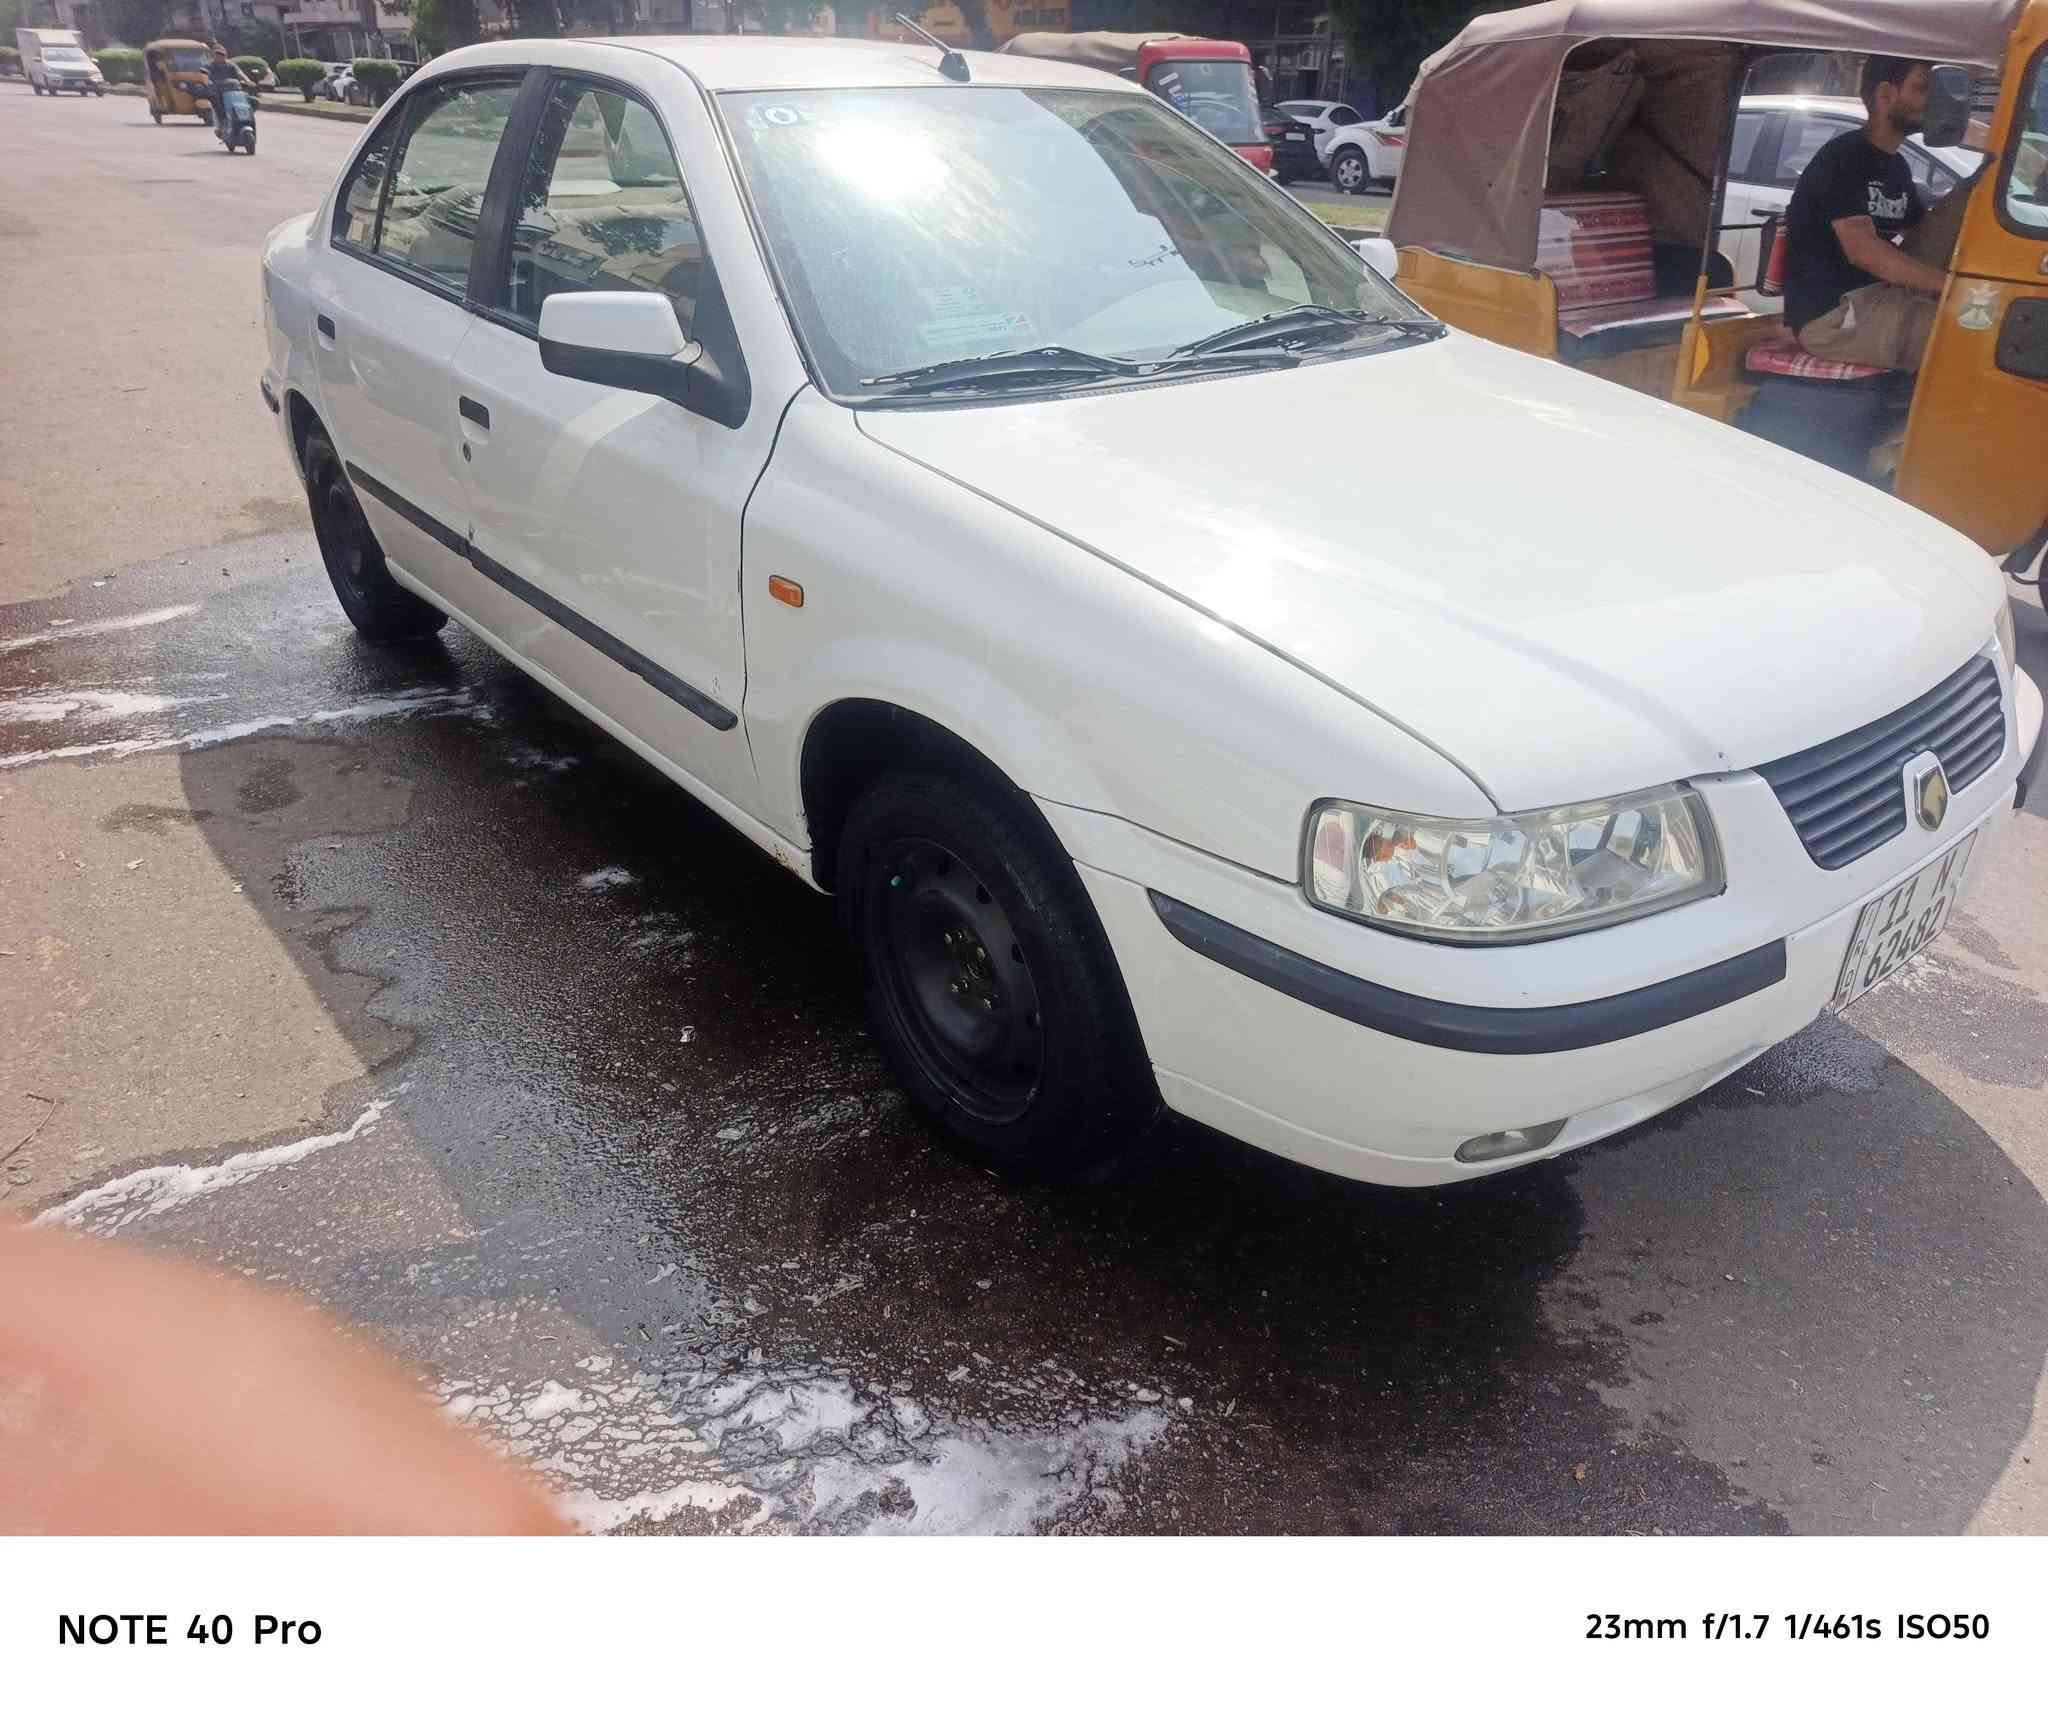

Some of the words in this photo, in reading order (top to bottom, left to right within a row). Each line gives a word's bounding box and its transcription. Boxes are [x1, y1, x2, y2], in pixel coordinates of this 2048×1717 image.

[1878, 876, 1920, 936] 11
[1931, 848, 1958, 900] N
[1863, 896, 1946, 988] 62482
